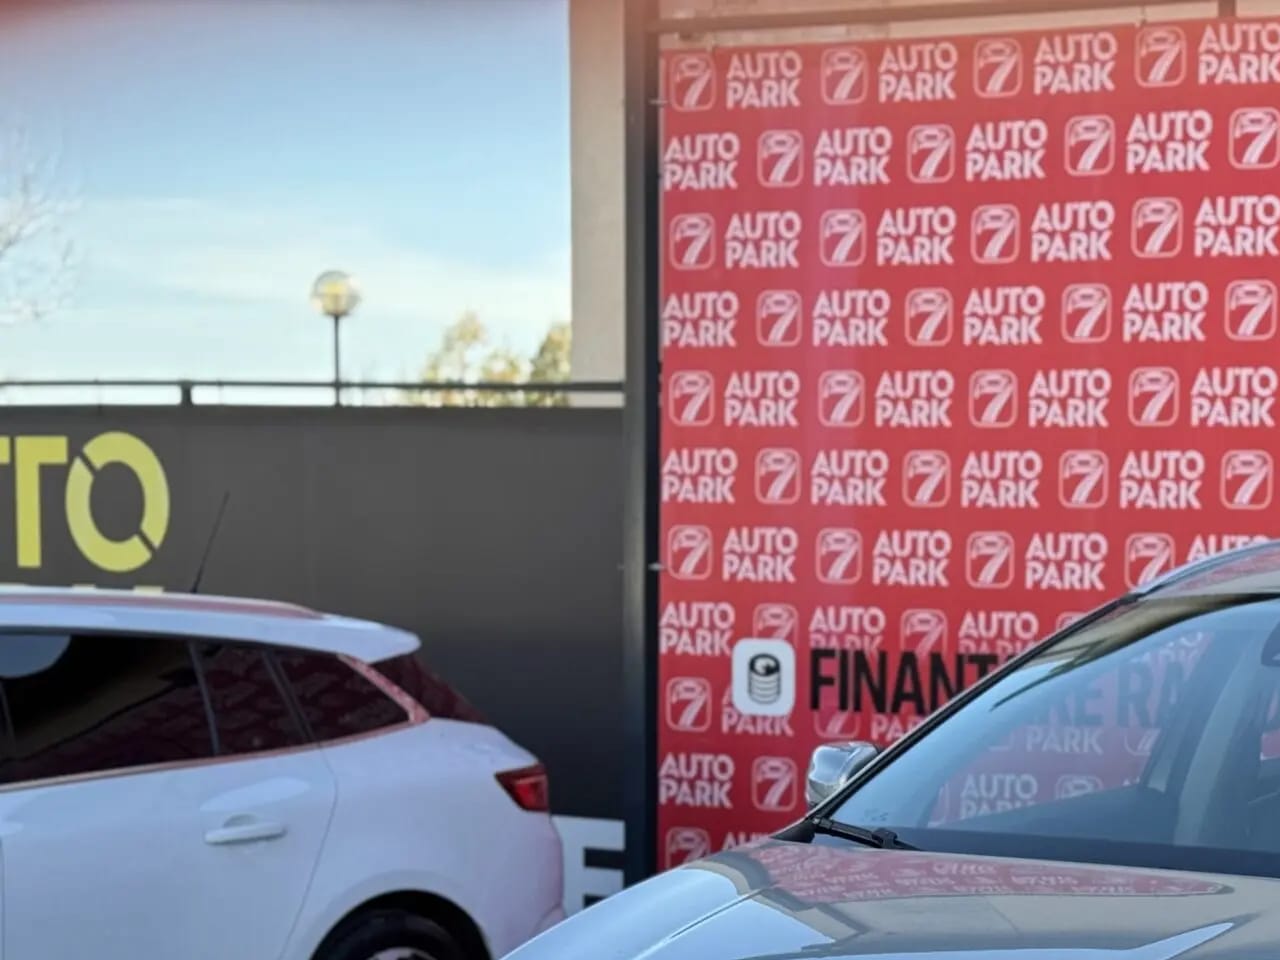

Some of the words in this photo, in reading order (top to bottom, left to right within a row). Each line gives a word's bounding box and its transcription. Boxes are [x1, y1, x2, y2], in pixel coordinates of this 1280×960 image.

[879, 42, 957, 73] AUTO
[1034, 32, 1117, 65] AUTO
[727, 51, 802, 80] AUTO
[1034, 60, 1115, 94] PARK
[727, 78, 800, 108] PARK
[879, 69, 955, 102] PARK
[966, 119, 1047, 153] AUTO
[1127, 110, 1212, 143] AUTO
[661, 133, 739, 163] AUTO
[814, 127, 892, 158] AUTO
[1127, 140, 1209, 173] PARK
[661, 160, 737, 190] PARK
[814, 156, 889, 186] PARK
[966, 148, 1045, 181] PARK
[725, 211, 801, 240] AUTO
[877, 207, 956, 237] AUTO
[1031, 201, 1114, 233] AUTO
[726, 239, 798, 268] PARK
[877, 234, 953, 265] PARK
[1032, 230, 1111, 261] PARK
[1195, 225, 1279, 256] PARK
[661, 291, 738, 321] AUTO
[813, 290, 890, 318] AUTO
[964, 286, 1044, 316] AUTO
[1123, 281, 1208, 312] AUTO
[662, 318, 735, 347] PARK
[813, 316, 887, 346] PARK
[964, 314, 1042, 345] PARK
[1124, 311, 1205, 341] PARK
[725, 371, 800, 399] AUTO
[876, 370, 954, 399] AUTO
[1029, 369, 1111, 398] AUTO
[1191, 367, 1277, 397] AUTO
[725, 397, 797, 426] PARK
[876, 397, 951, 427] PARK
[1029, 398, 1108, 427] PARK
[1191, 396, 1274, 426] PARK
[662, 448, 737, 476] AUTO
[811, 450, 888, 478] AUTO
[962, 450, 1042, 479] AUTO
[1120, 450, 1204, 479] AUTO
[662, 474, 734, 502] PARK
[811, 476, 885, 505] PARK
[962, 479, 1038, 507] PARK
[1120, 479, 1201, 509] PARK
[723, 527, 798, 555] AUTO
[873, 530, 951, 558] AUTO
[1026, 533, 1107, 561] AUTO
[723, 553, 795, 582] PARK
[873, 556, 948, 586] PARK
[1026, 560, 1104, 590] PARK
[659, 602, 735, 630] AUTO
[809, 606, 886, 634] AUTO
[959, 612, 1039, 639] AUTO
[659, 628, 734, 657] PARK
[1026, 726, 1103, 755] PARK
[659, 753, 734, 781] AUTO
[660, 777, 731, 807] PARK
[961, 774, 1039, 800] AUTO
